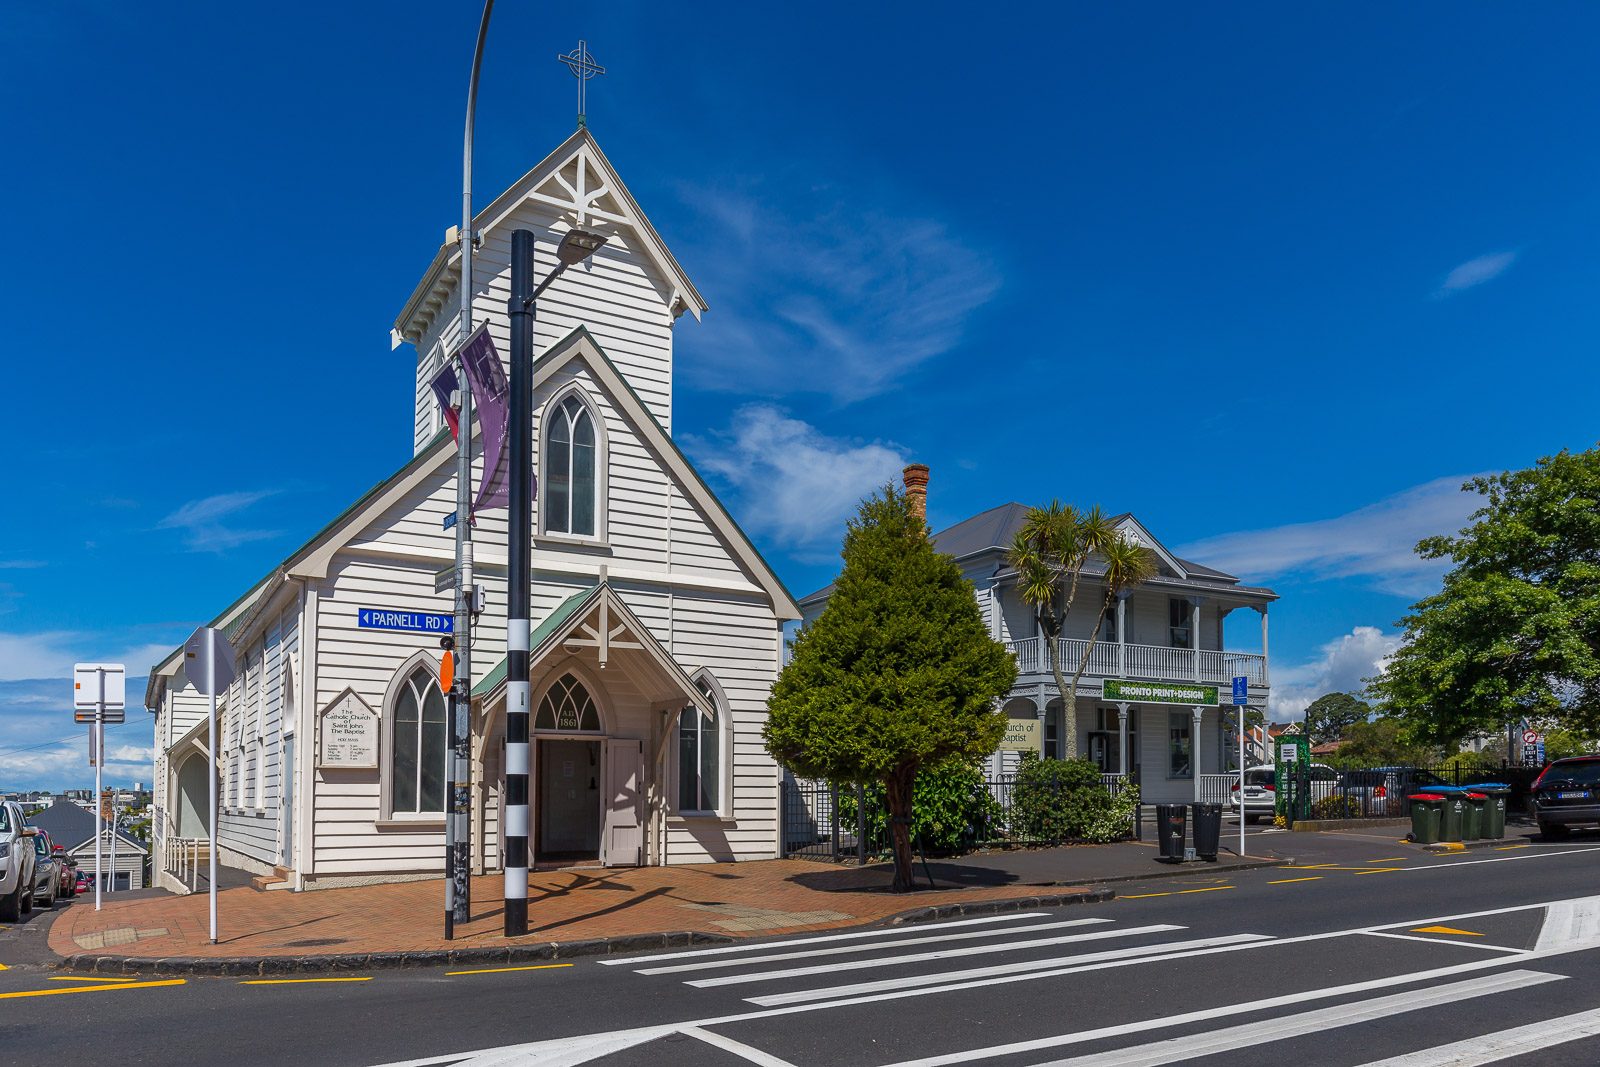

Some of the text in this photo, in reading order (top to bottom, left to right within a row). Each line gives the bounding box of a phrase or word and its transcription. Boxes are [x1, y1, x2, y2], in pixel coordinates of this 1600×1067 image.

[372, 612, 440, 629] PARNELL RD
[1237, 677, 1243, 685] P
[1120, 686, 1152, 696] PRONTO
[560, 718, 576, 726] 1861
[1006, 722, 1035, 733] urch of
